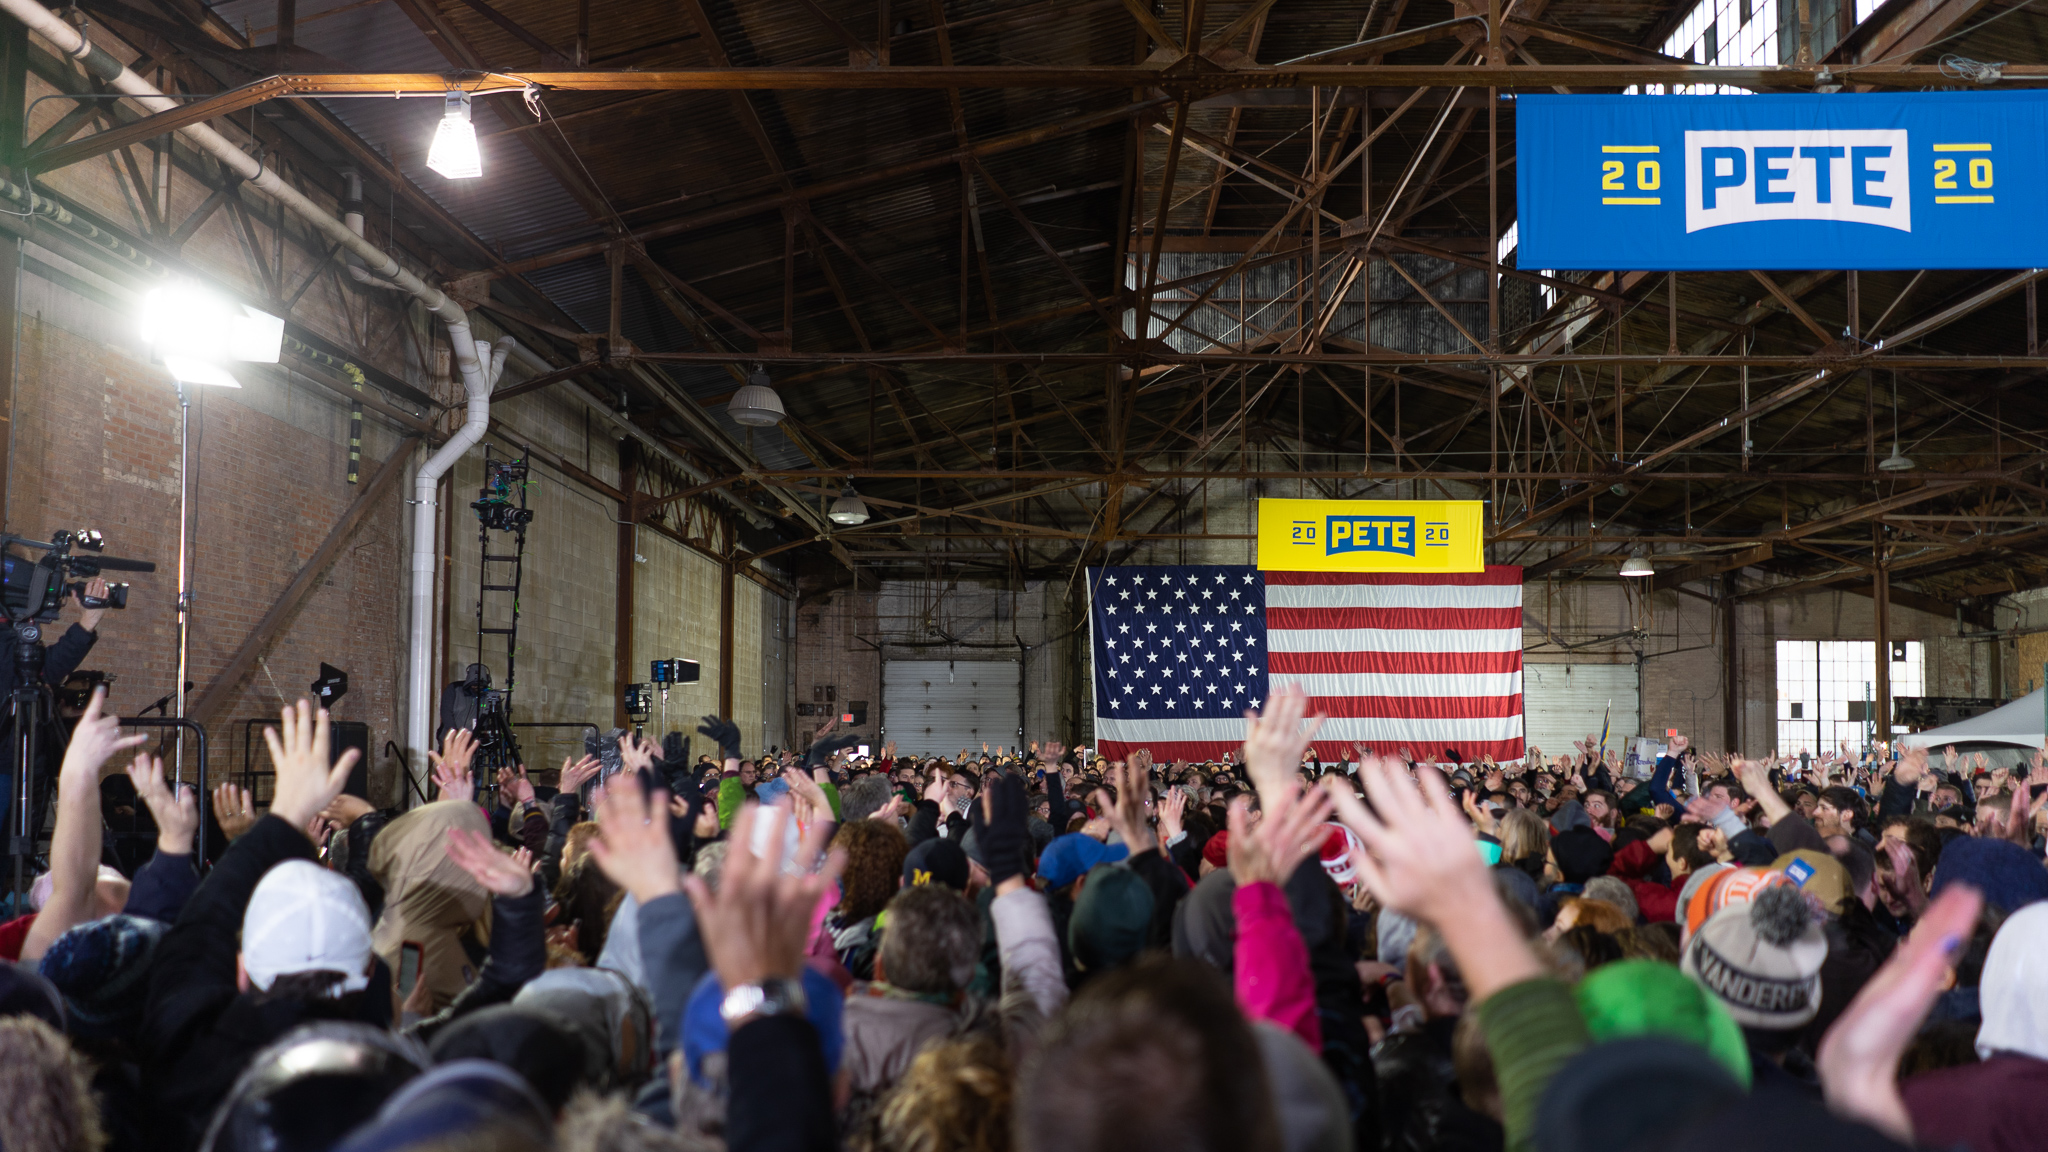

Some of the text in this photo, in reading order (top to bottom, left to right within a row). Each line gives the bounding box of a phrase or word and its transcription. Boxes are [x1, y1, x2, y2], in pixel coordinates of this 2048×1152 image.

[1602, 145, 1994, 209] 20 PETE 20
[1293, 521, 1449, 549] 20 PETE 20
[912, 868, 933, 886] M
